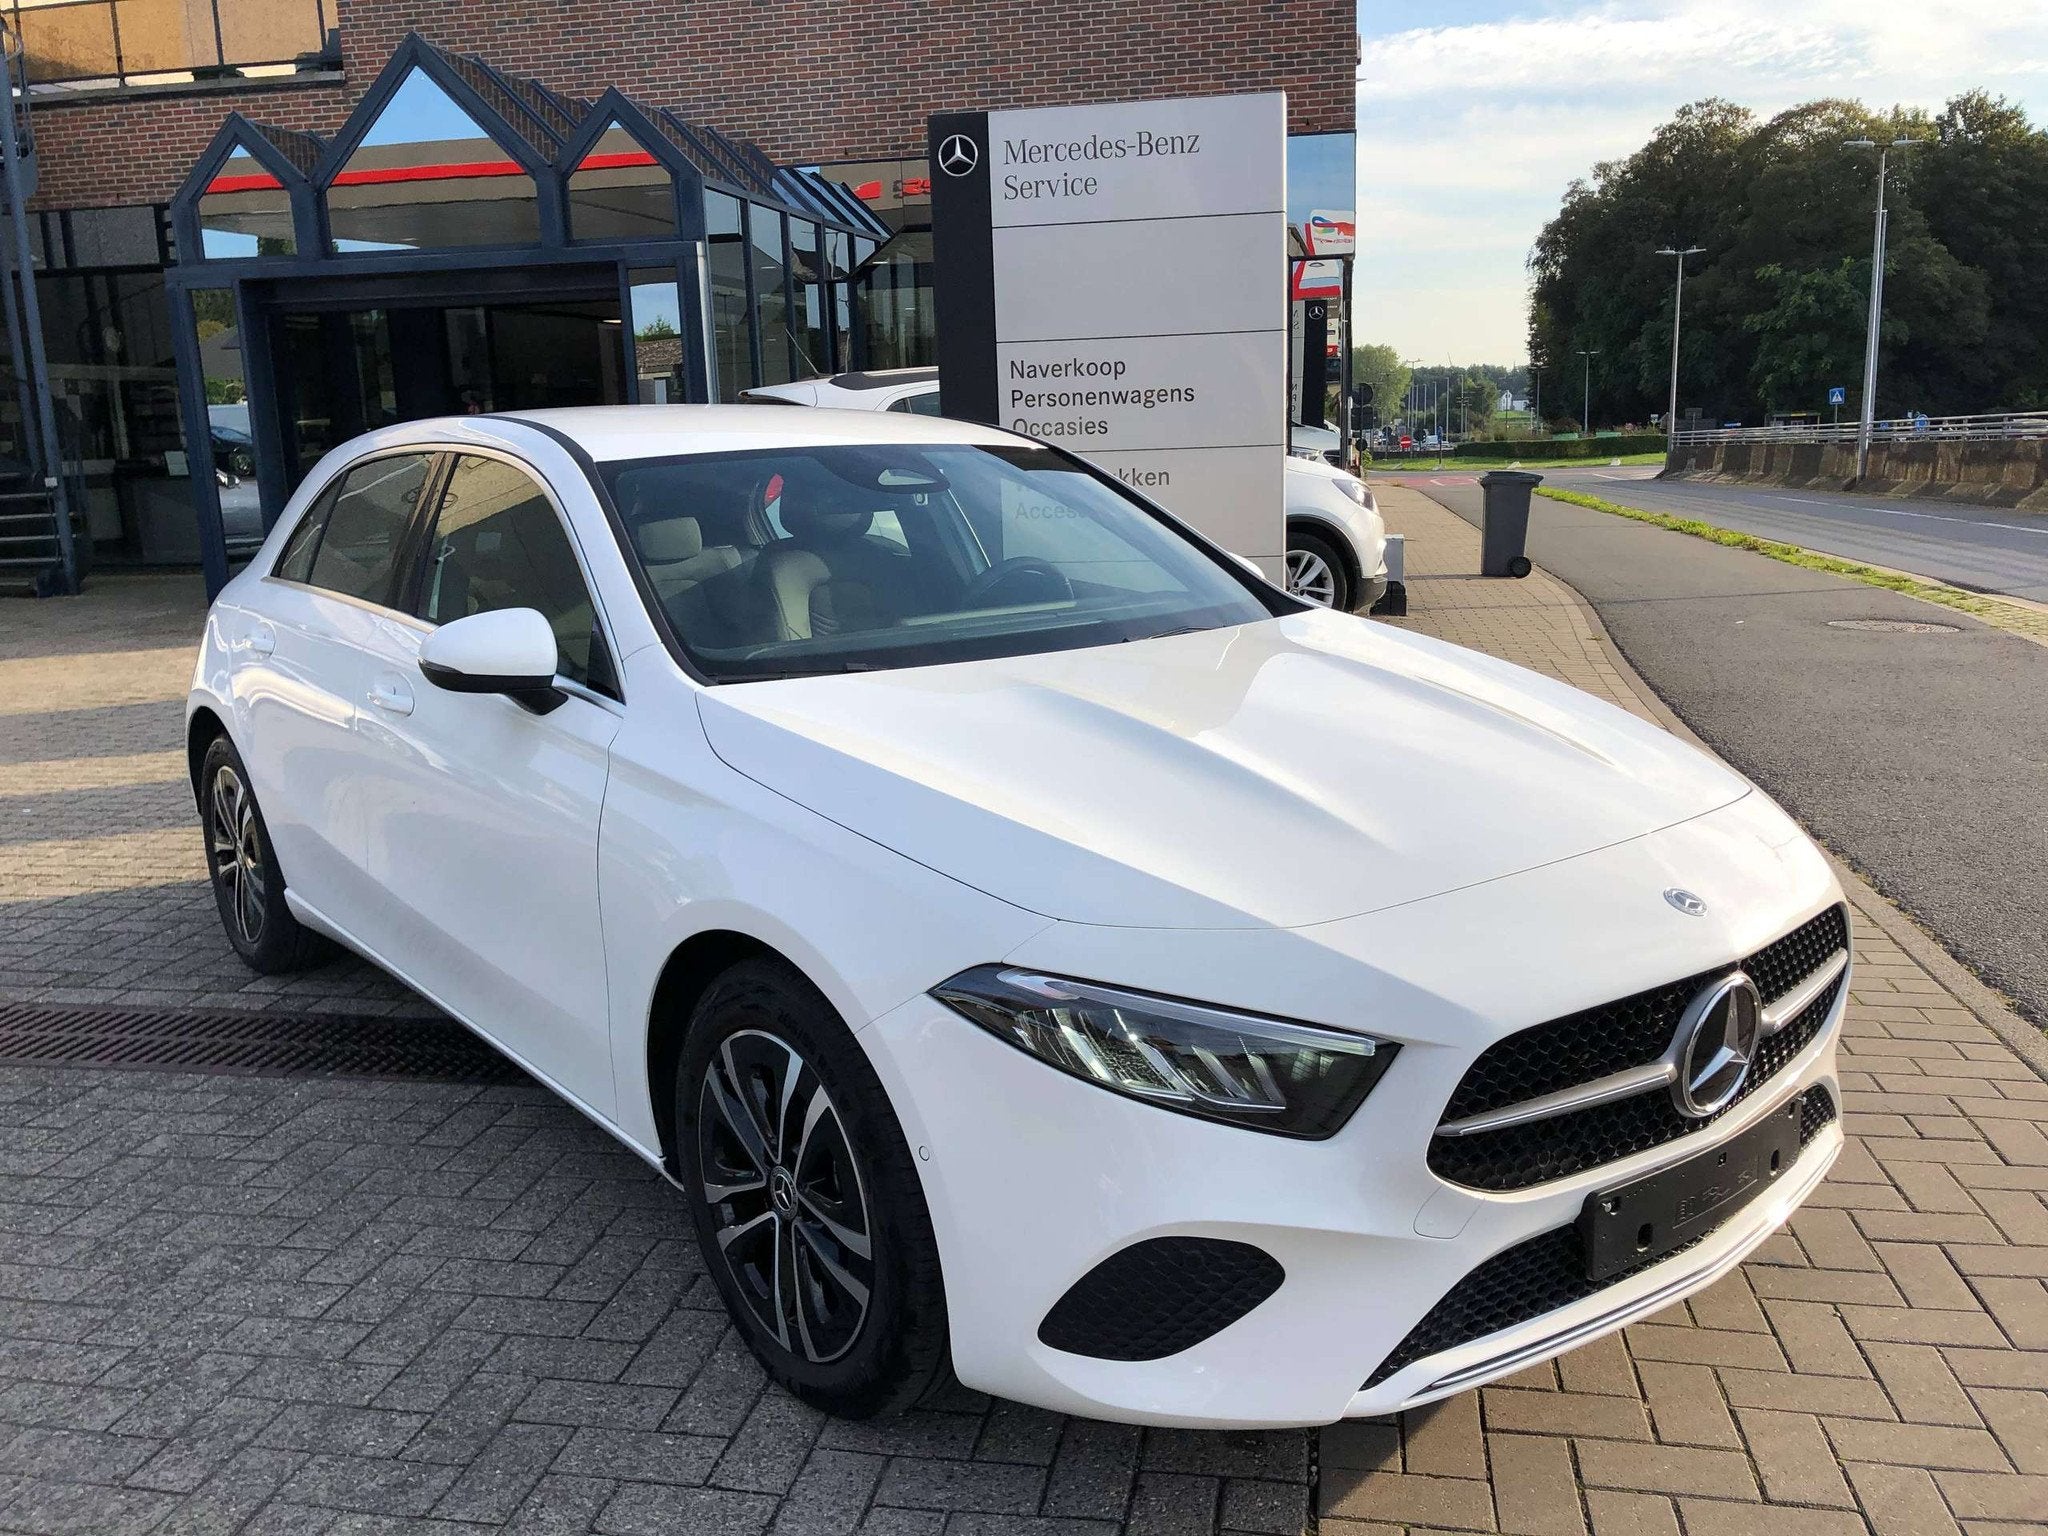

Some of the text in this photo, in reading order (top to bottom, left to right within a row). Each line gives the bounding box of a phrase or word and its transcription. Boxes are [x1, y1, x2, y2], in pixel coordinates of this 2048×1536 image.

[1003, 131, 1200, 165] Mercedes-Benz
[1003, 172, 1098, 200] Service
[1010, 358, 1126, 380] Naverkoop
[1011, 387, 1195, 409] Personenwagens
[1013, 416, 1108, 436] Occasies
